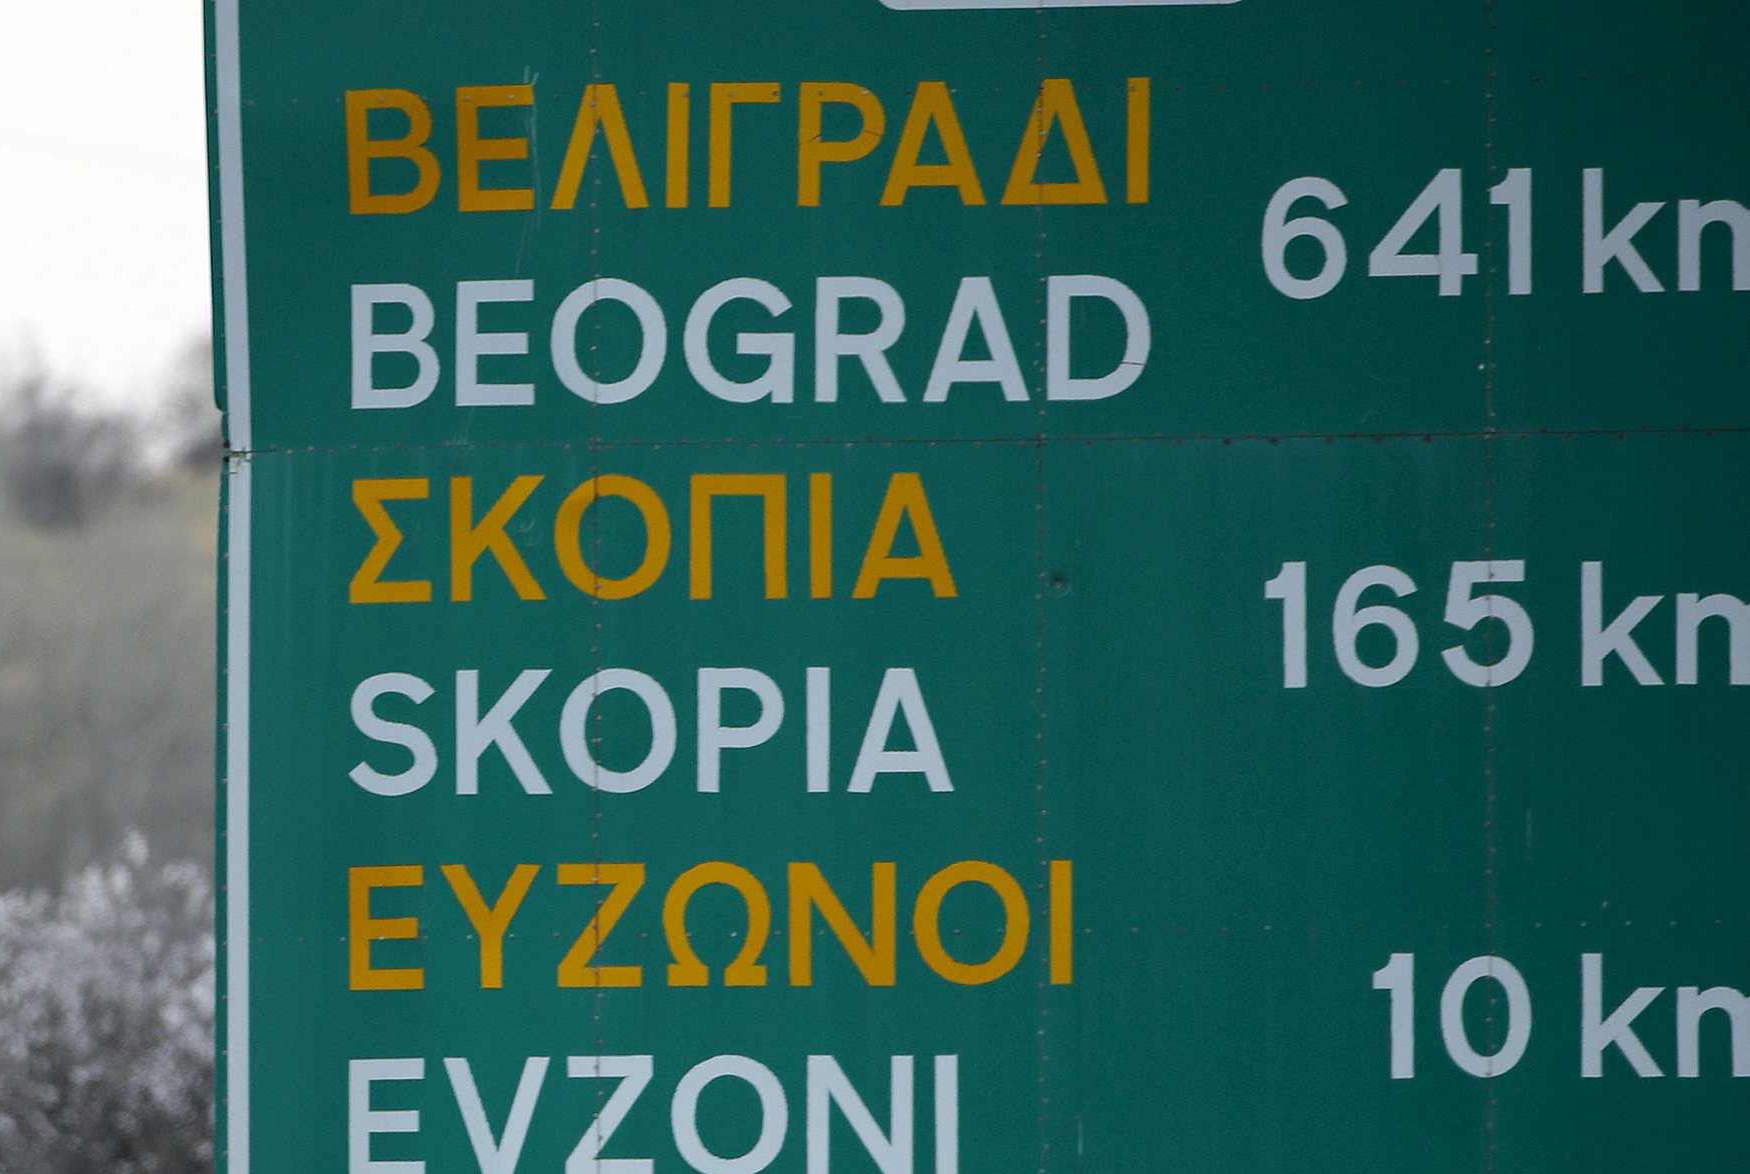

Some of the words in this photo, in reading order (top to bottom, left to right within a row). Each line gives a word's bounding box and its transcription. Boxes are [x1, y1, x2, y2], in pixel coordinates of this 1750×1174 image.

[345, 78, 1150, 216] ΒΕΛΙΓΡΑΔΙ
[1262, 168, 1533, 300] 641
[351, 274, 1150, 410] BEOGRAD
[349, 473, 958, 604] ΣΚΟΠΙΑ
[1265, 559, 1535, 688] 165
[349, 666, 954, 796] SKOPIA
[348, 860, 1073, 991] ΕΥΖΩΝΟΙ
[1372, 952, 1532, 1079] 10
